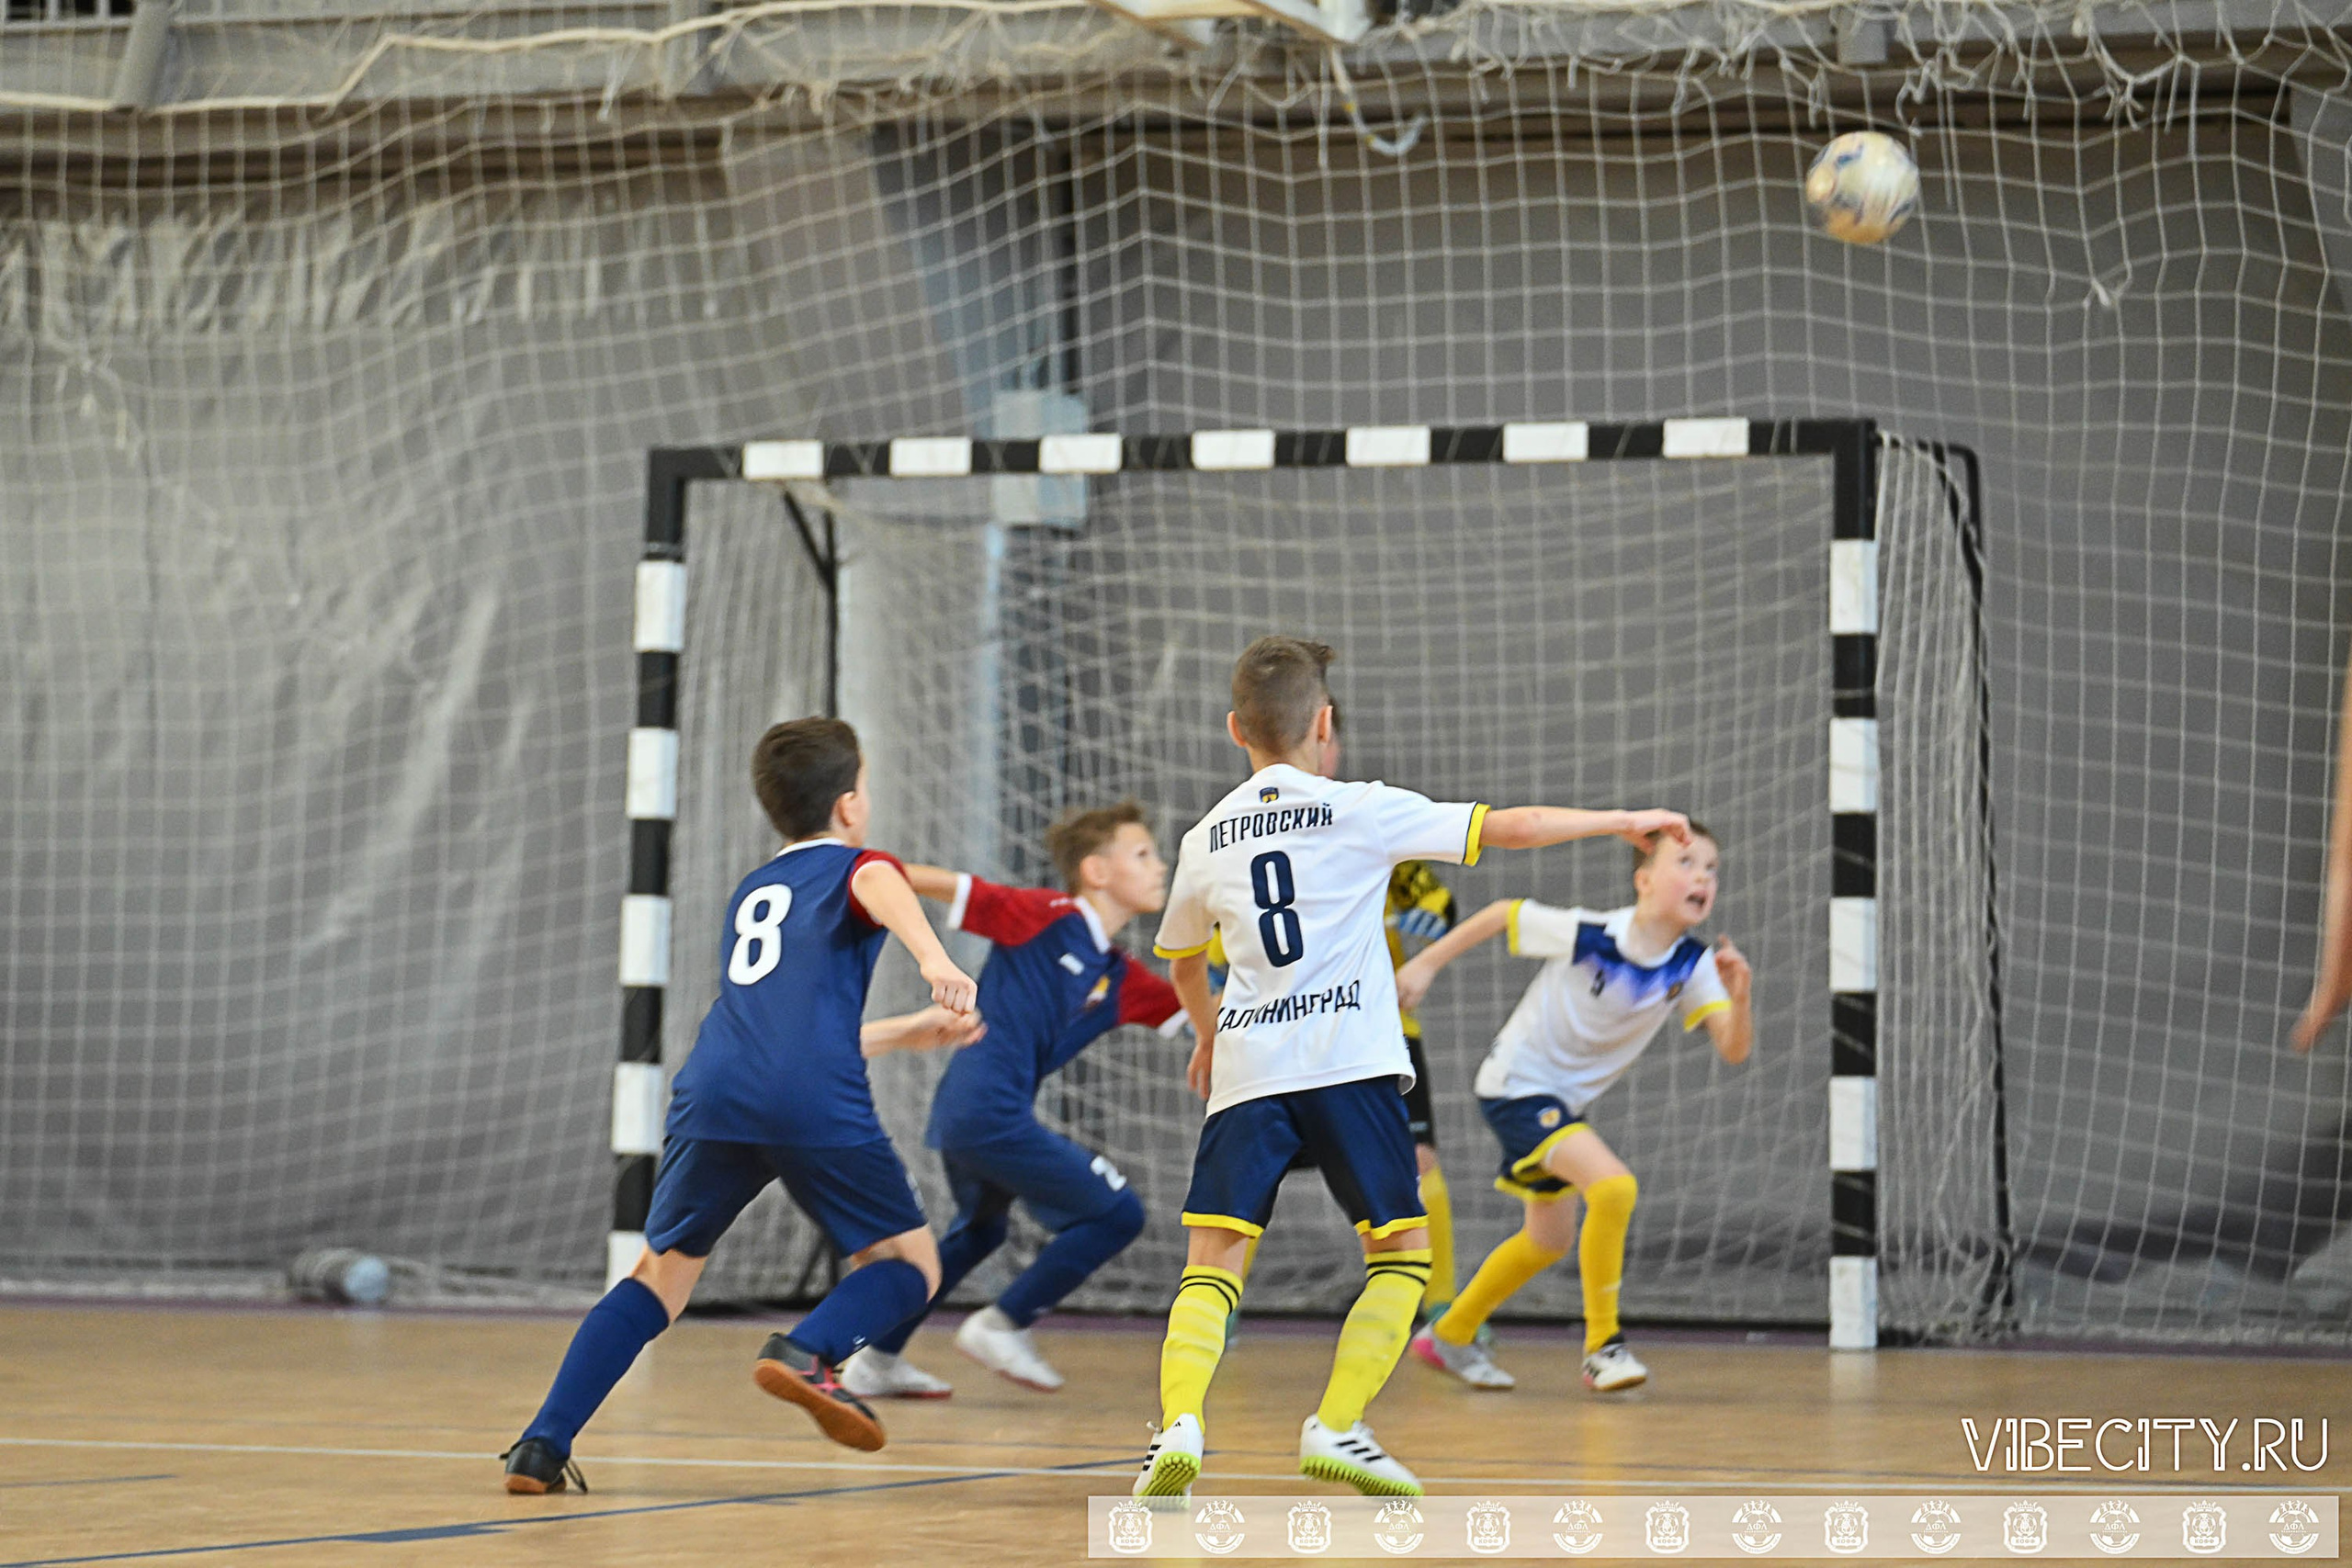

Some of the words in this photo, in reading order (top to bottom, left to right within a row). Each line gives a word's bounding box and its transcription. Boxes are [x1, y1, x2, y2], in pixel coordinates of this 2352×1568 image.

[1209, 802, 1333, 853] ПЕТРОВСКИЙ
[728, 883, 794, 986] 8
[1250, 850, 1304, 969] 8
